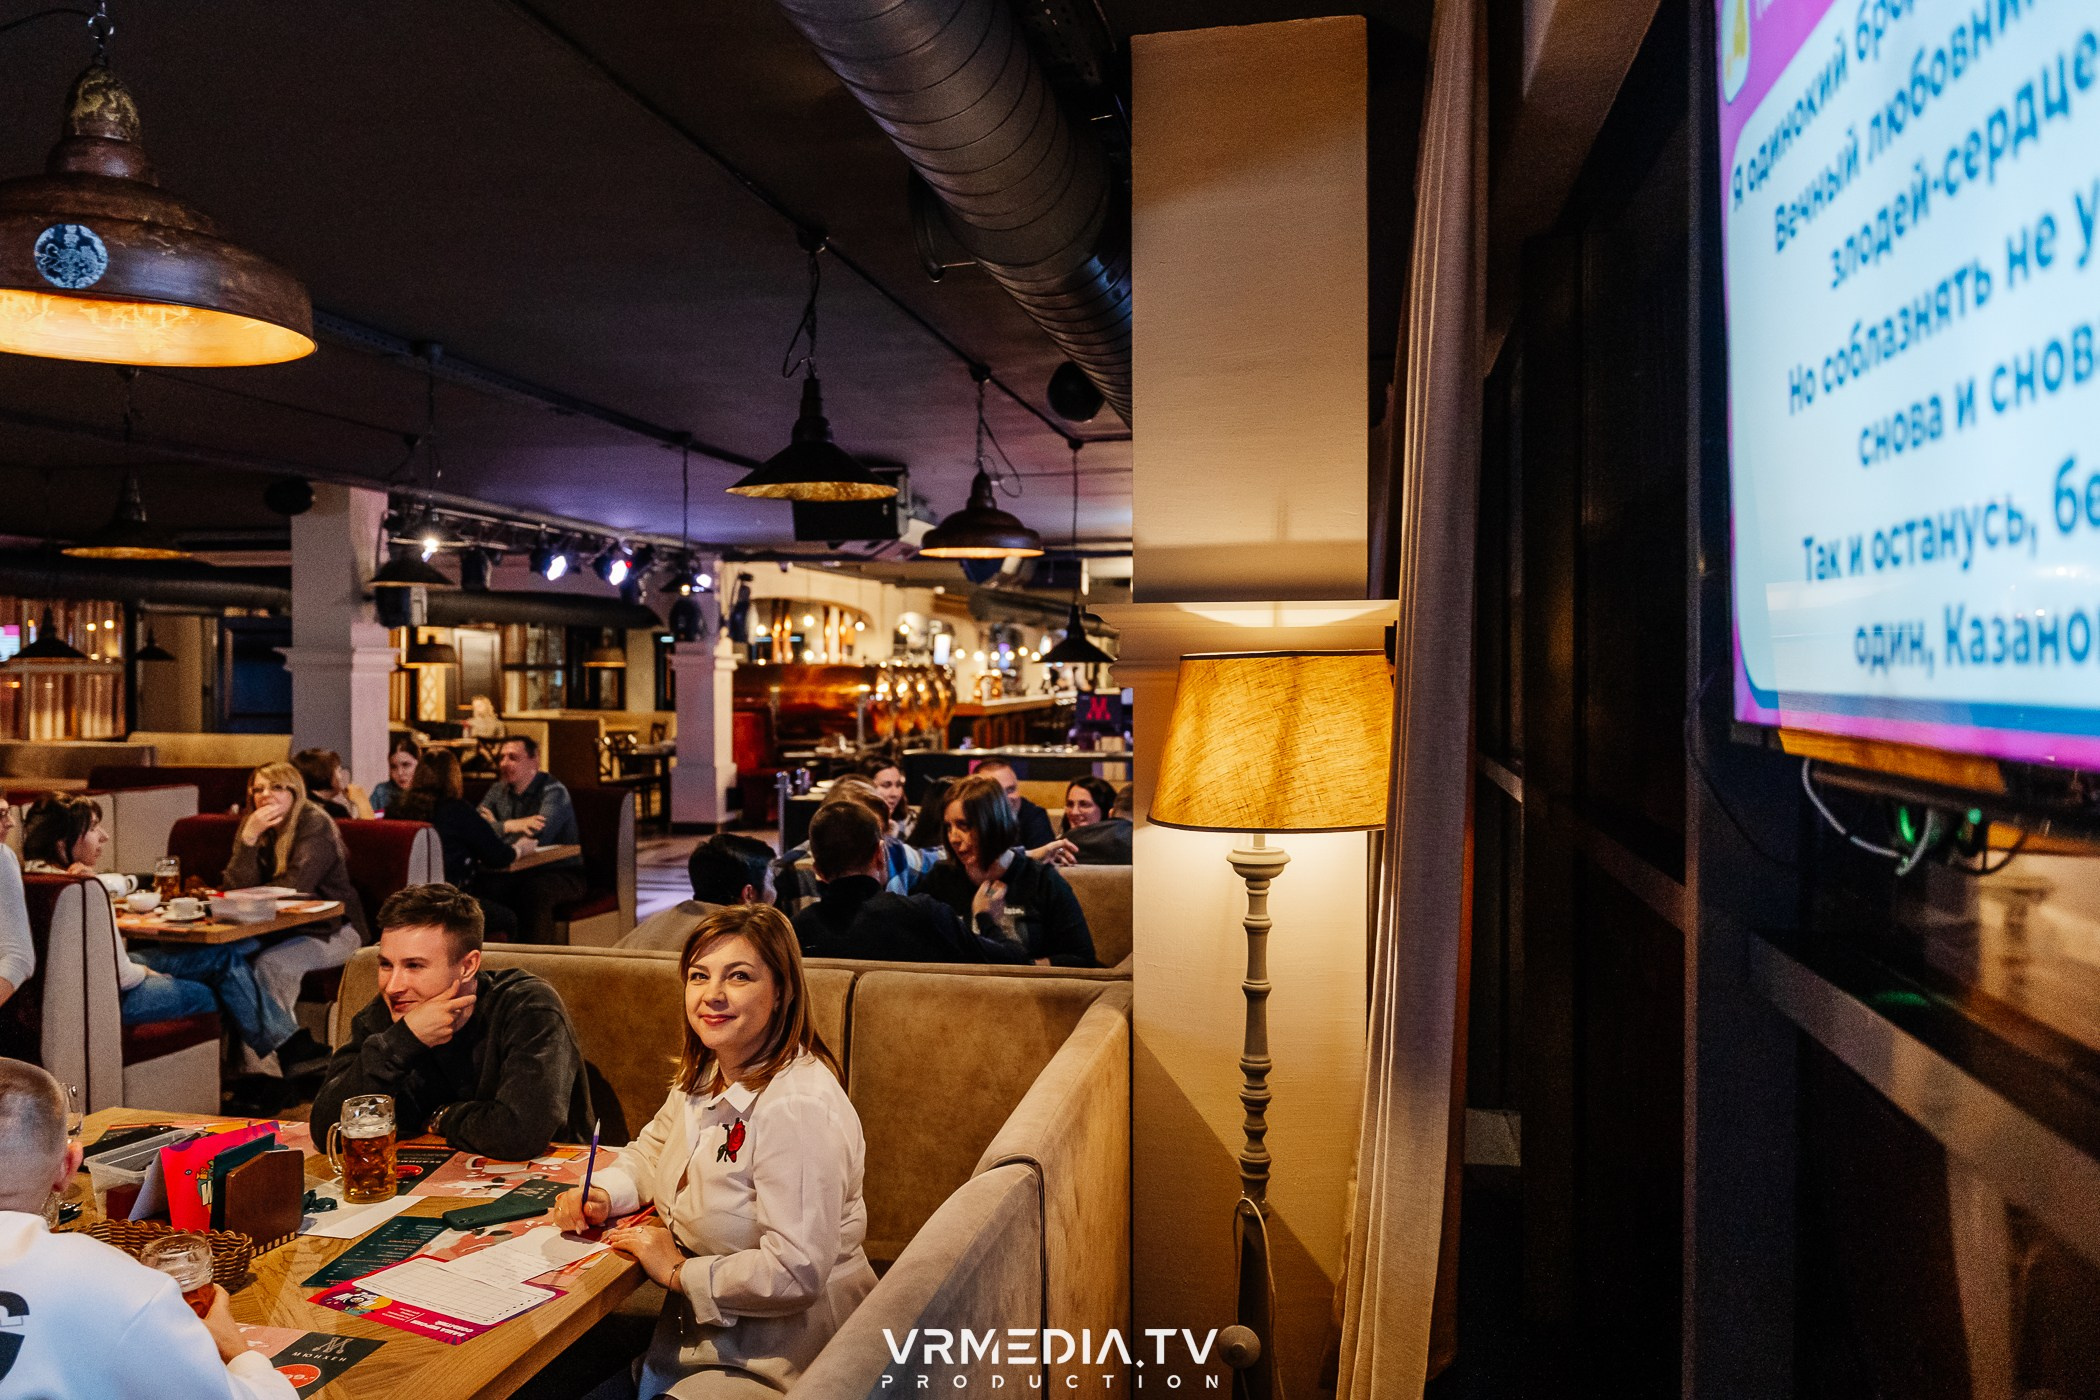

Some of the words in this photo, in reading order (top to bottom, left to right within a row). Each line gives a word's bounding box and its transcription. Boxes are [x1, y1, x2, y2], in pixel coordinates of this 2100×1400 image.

[1748, 33, 1847, 192] одинокий
[1775, 123, 1860, 254] Вечный
[1867, 0, 2034, 164] любовни
[1789, 364, 1816, 416] Но
[1822, 258, 1994, 394] соблазнять
[2006, 212, 2057, 290] не
[1858, 393, 1944, 467] снова
[1955, 374, 1977, 430] и
[1802, 534, 1842, 583] Так
[1849, 530, 1865, 577] и
[1872, 494, 2038, 572] останусь,
[1854, 618, 1936, 680] один,
[1944, 605, 2100, 668] Казано
[291, 1351, 347, 1362] МЮНХЕН
